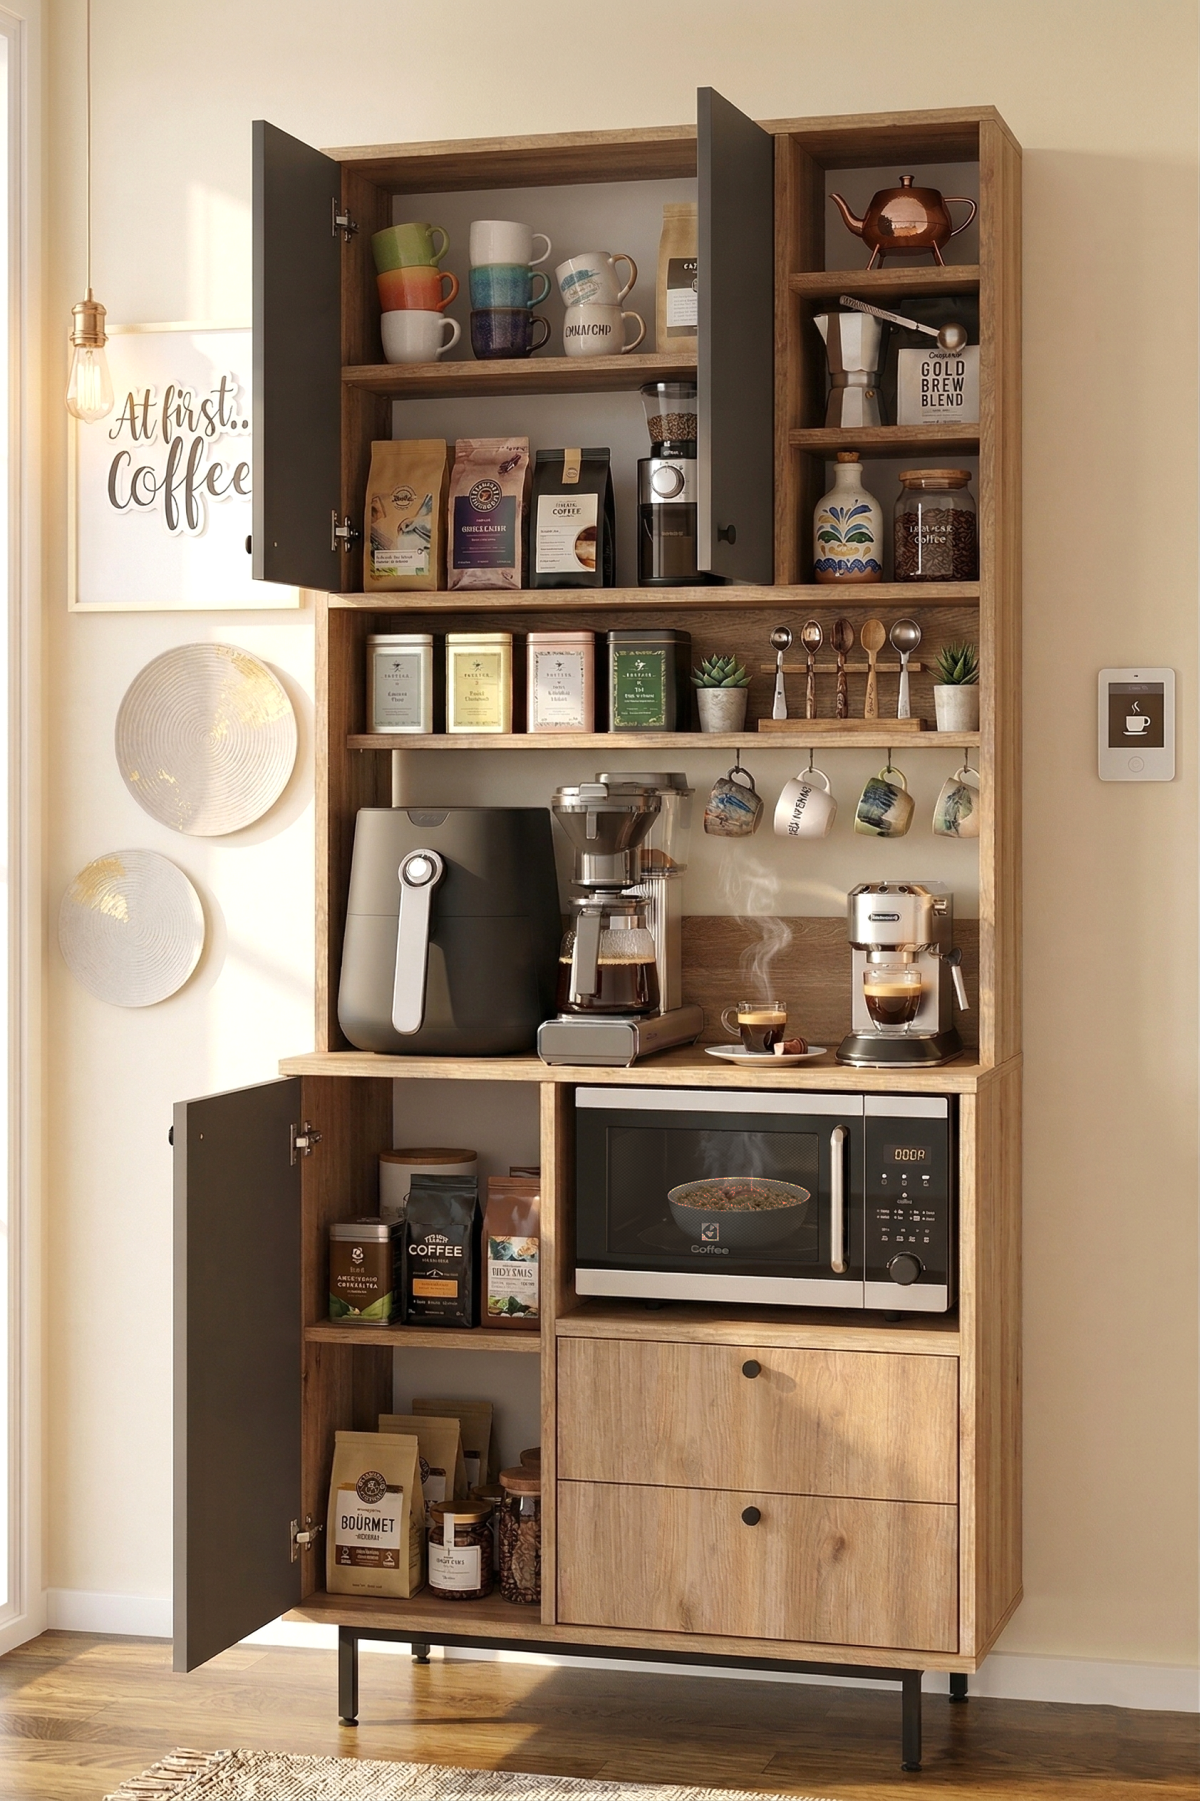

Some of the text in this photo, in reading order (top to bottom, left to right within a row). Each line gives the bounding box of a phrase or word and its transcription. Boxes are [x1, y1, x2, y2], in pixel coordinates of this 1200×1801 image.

[921, 360, 965, 377] GOLD
[921, 377, 965, 393] BREW
[921, 393, 963, 407] BLEND
[108, 388, 158, 442] At
[107, 435, 252, 531] Coffee
[552, 507, 582, 515] COFFEE
[408, 1244, 463, 1257] COFFEE
[690, 1244, 730, 1255] Coffee
[341, 1513, 395, 1533] BOÜRMET
